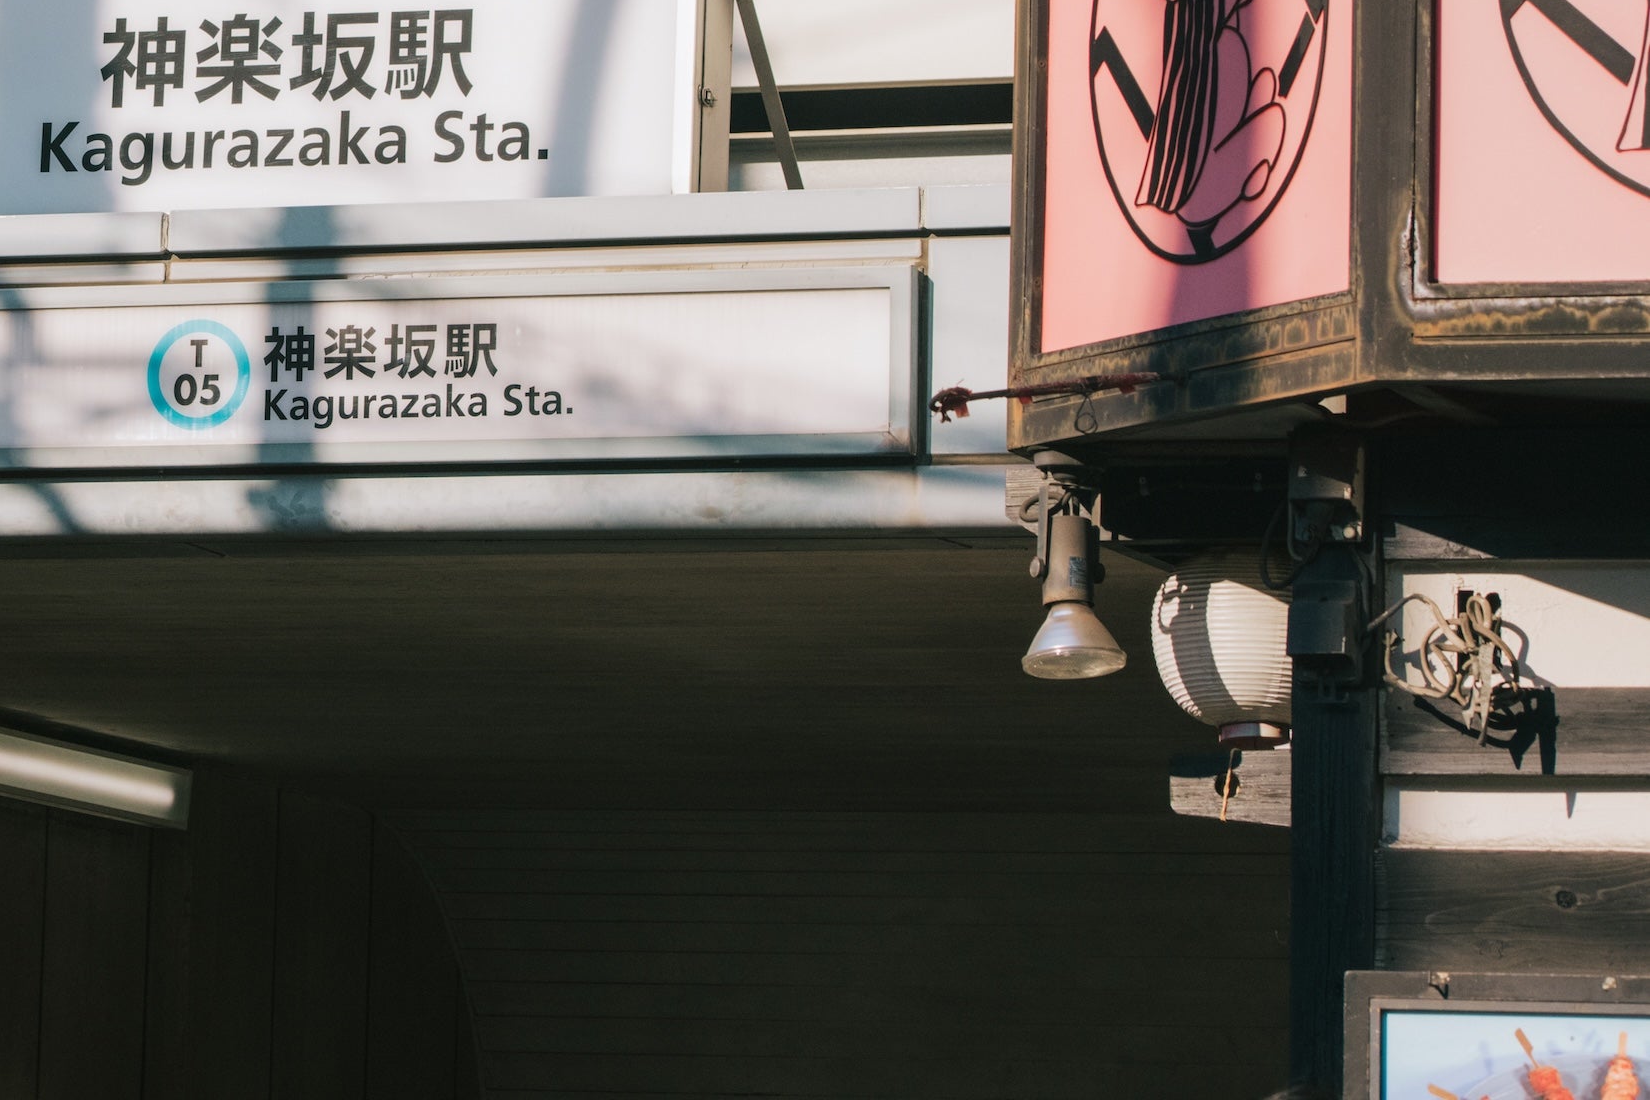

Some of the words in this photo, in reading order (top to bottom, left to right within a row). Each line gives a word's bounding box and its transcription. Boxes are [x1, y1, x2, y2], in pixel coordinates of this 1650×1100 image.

[100, 8, 474, 108] 神楽坂駅
[39, 111, 408, 186] Kagurazaka
[433, 109, 550, 163] Sta.
[190, 339, 208, 368] T
[263, 322, 499, 382] 神楽坂駅
[172, 373, 222, 407] 05
[263, 384, 490, 429] Kagurazaka
[502, 382, 575, 417] Sta.
